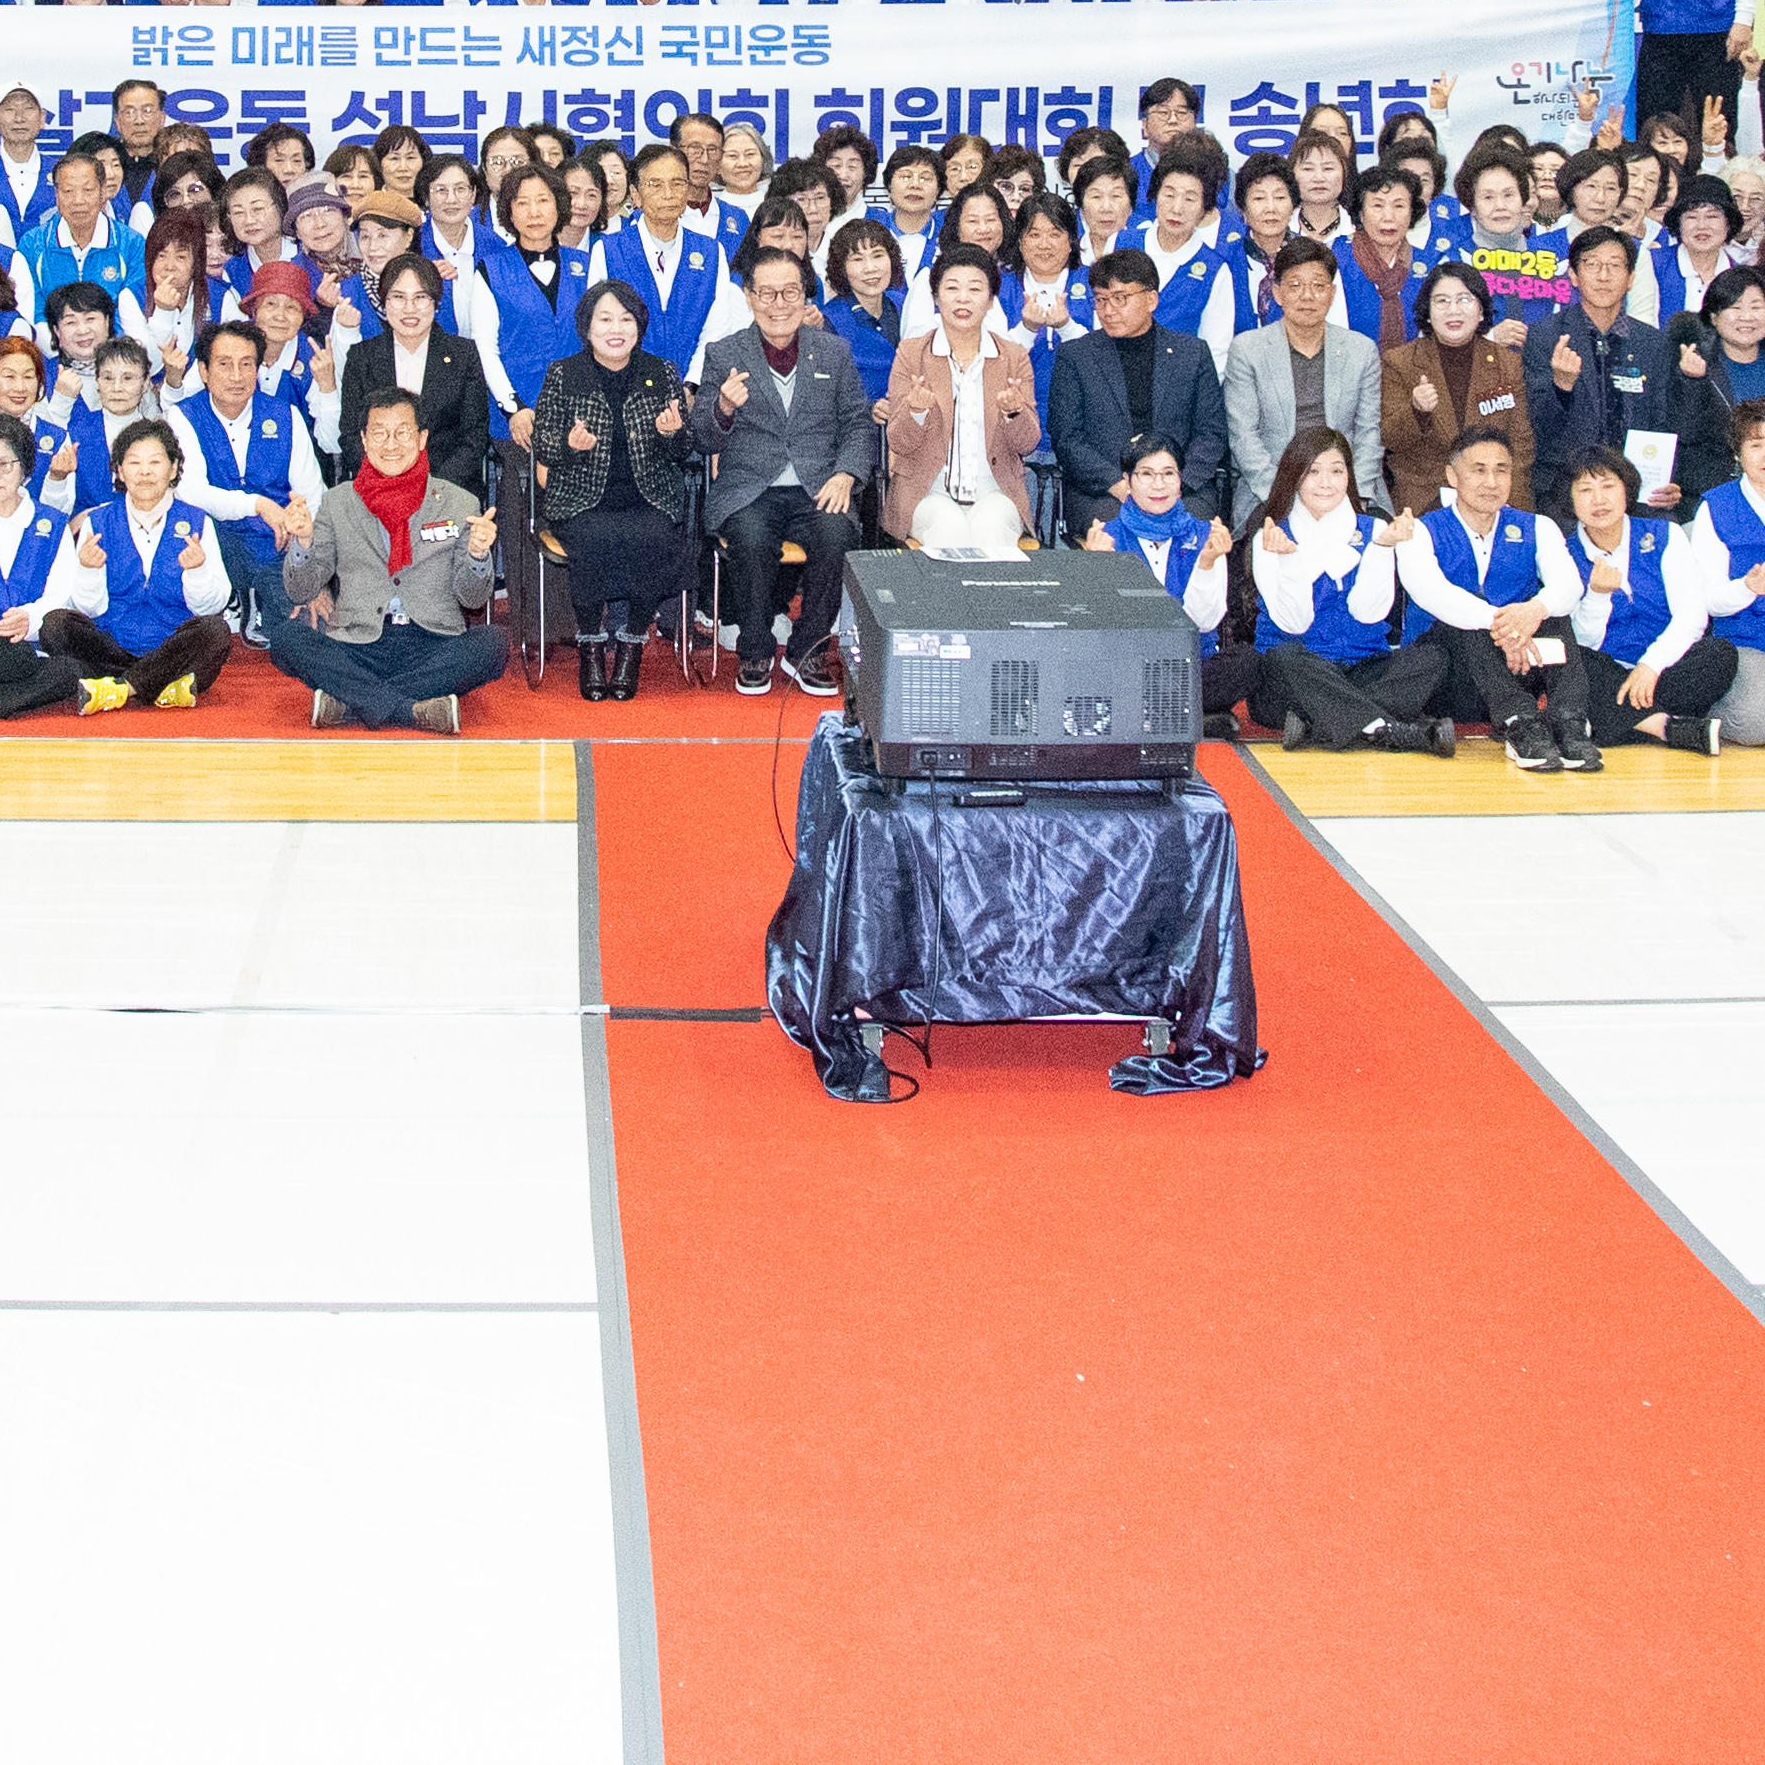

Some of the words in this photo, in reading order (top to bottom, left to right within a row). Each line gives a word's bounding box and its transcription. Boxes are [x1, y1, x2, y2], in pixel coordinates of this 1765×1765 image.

[131, 25, 216, 67] 밝은
[233, 25, 359, 67] 미래를
[373, 25, 502, 67] 만드는
[516, 24, 645, 67] 새정신
[658, 24, 832, 67] 국민운동
[1472, 249, 1558, 280] 이매2동
